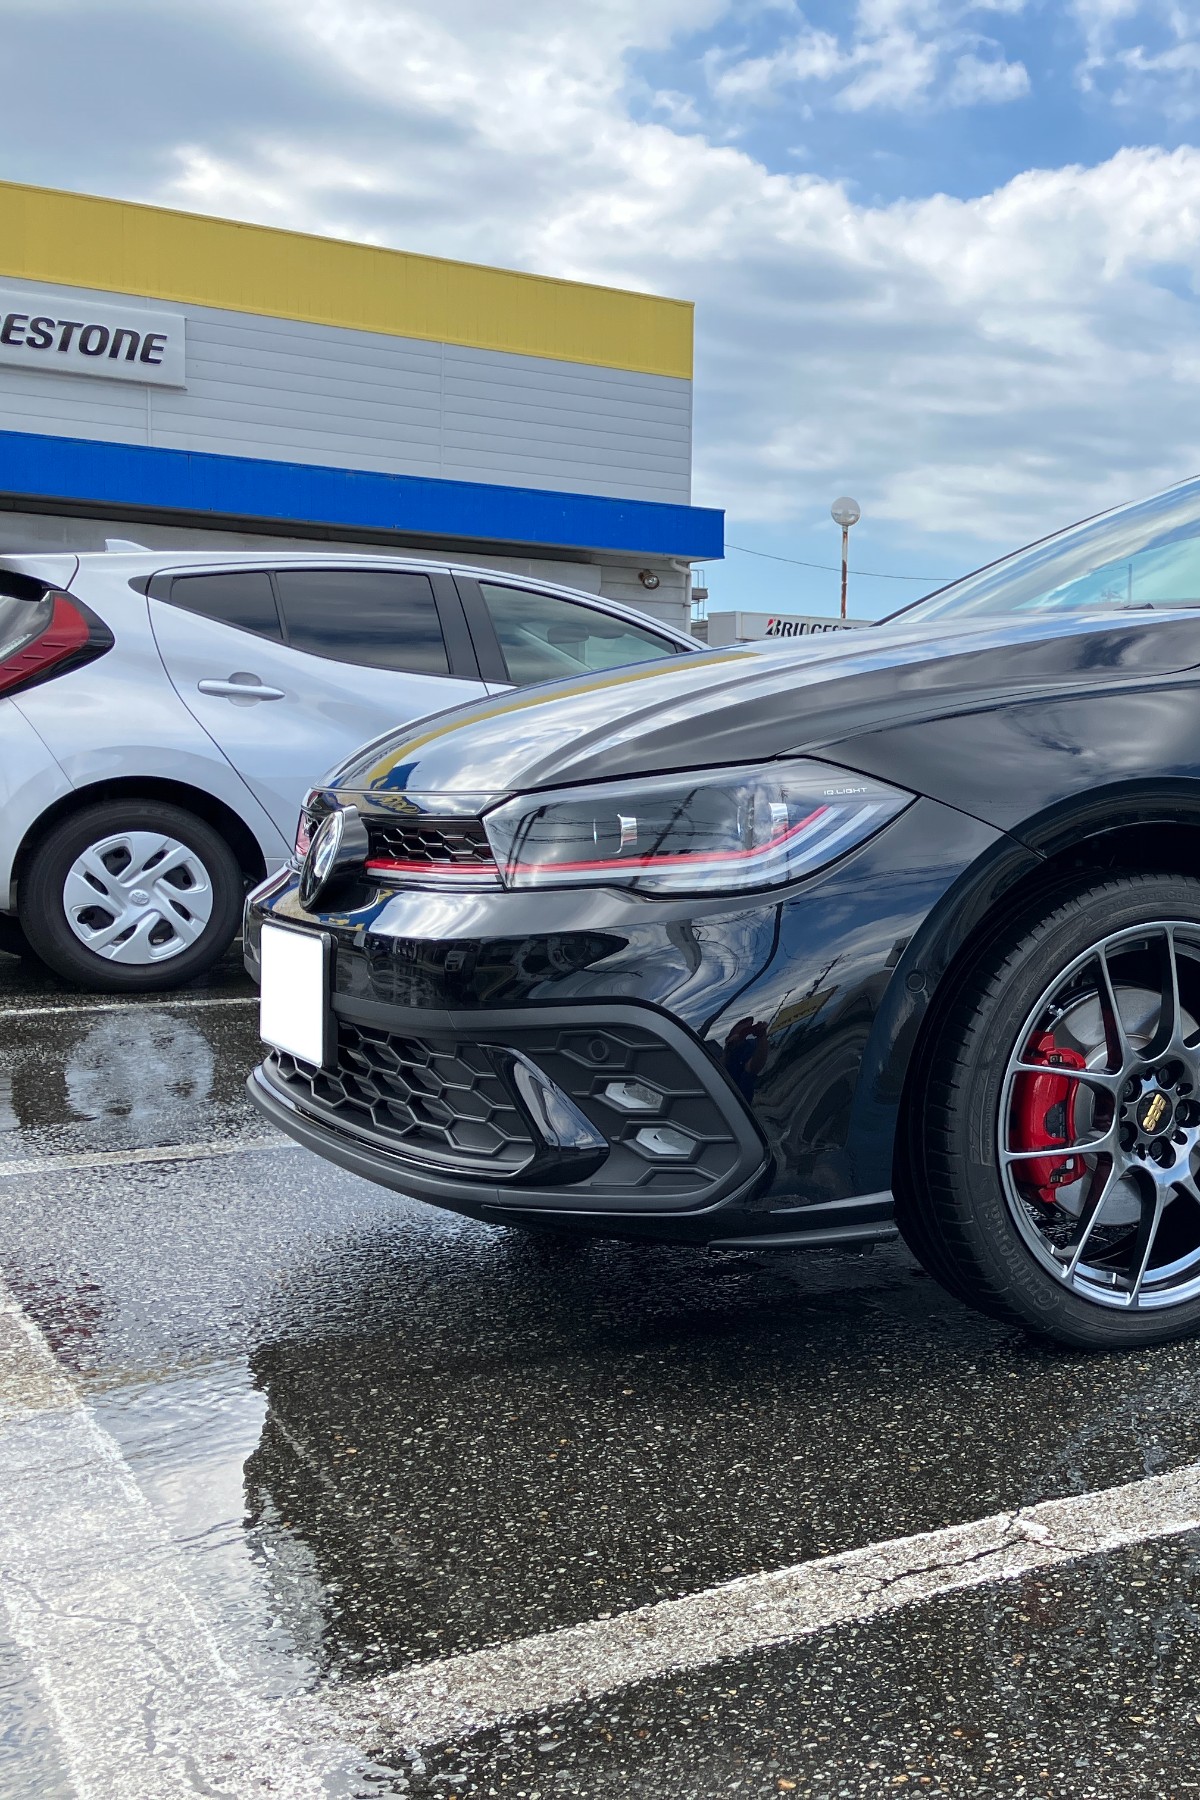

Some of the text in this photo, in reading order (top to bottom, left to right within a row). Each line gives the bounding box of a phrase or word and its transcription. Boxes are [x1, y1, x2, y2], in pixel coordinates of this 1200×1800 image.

[0, 313, 168, 365] ESTONE
[765, 618, 859, 638] BRIDGE
[823, 787, 868, 796] IQ.LIGHT
[1142, 1093, 1167, 1132] BBS
